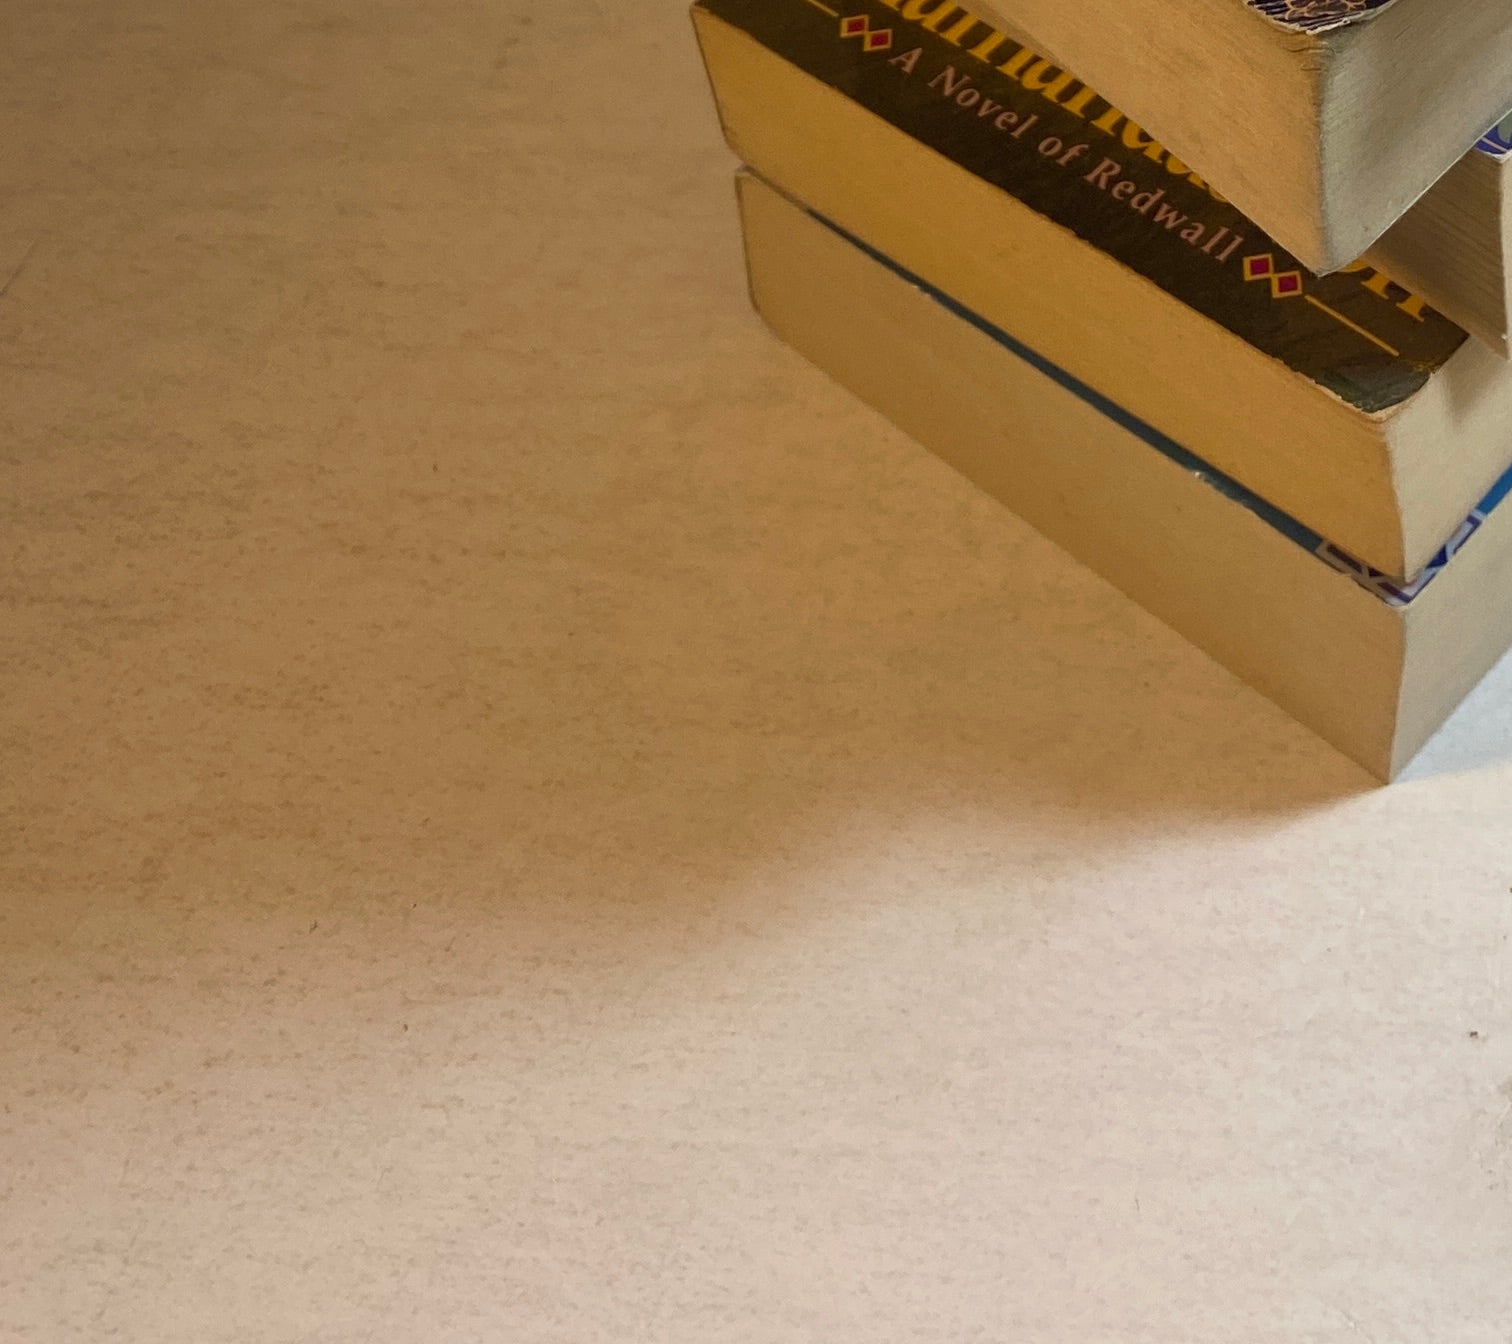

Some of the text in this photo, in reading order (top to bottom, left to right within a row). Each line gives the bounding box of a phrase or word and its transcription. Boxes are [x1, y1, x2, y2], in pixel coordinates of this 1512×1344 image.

[888, 47, 1245, 264] A Novel of Redwall
